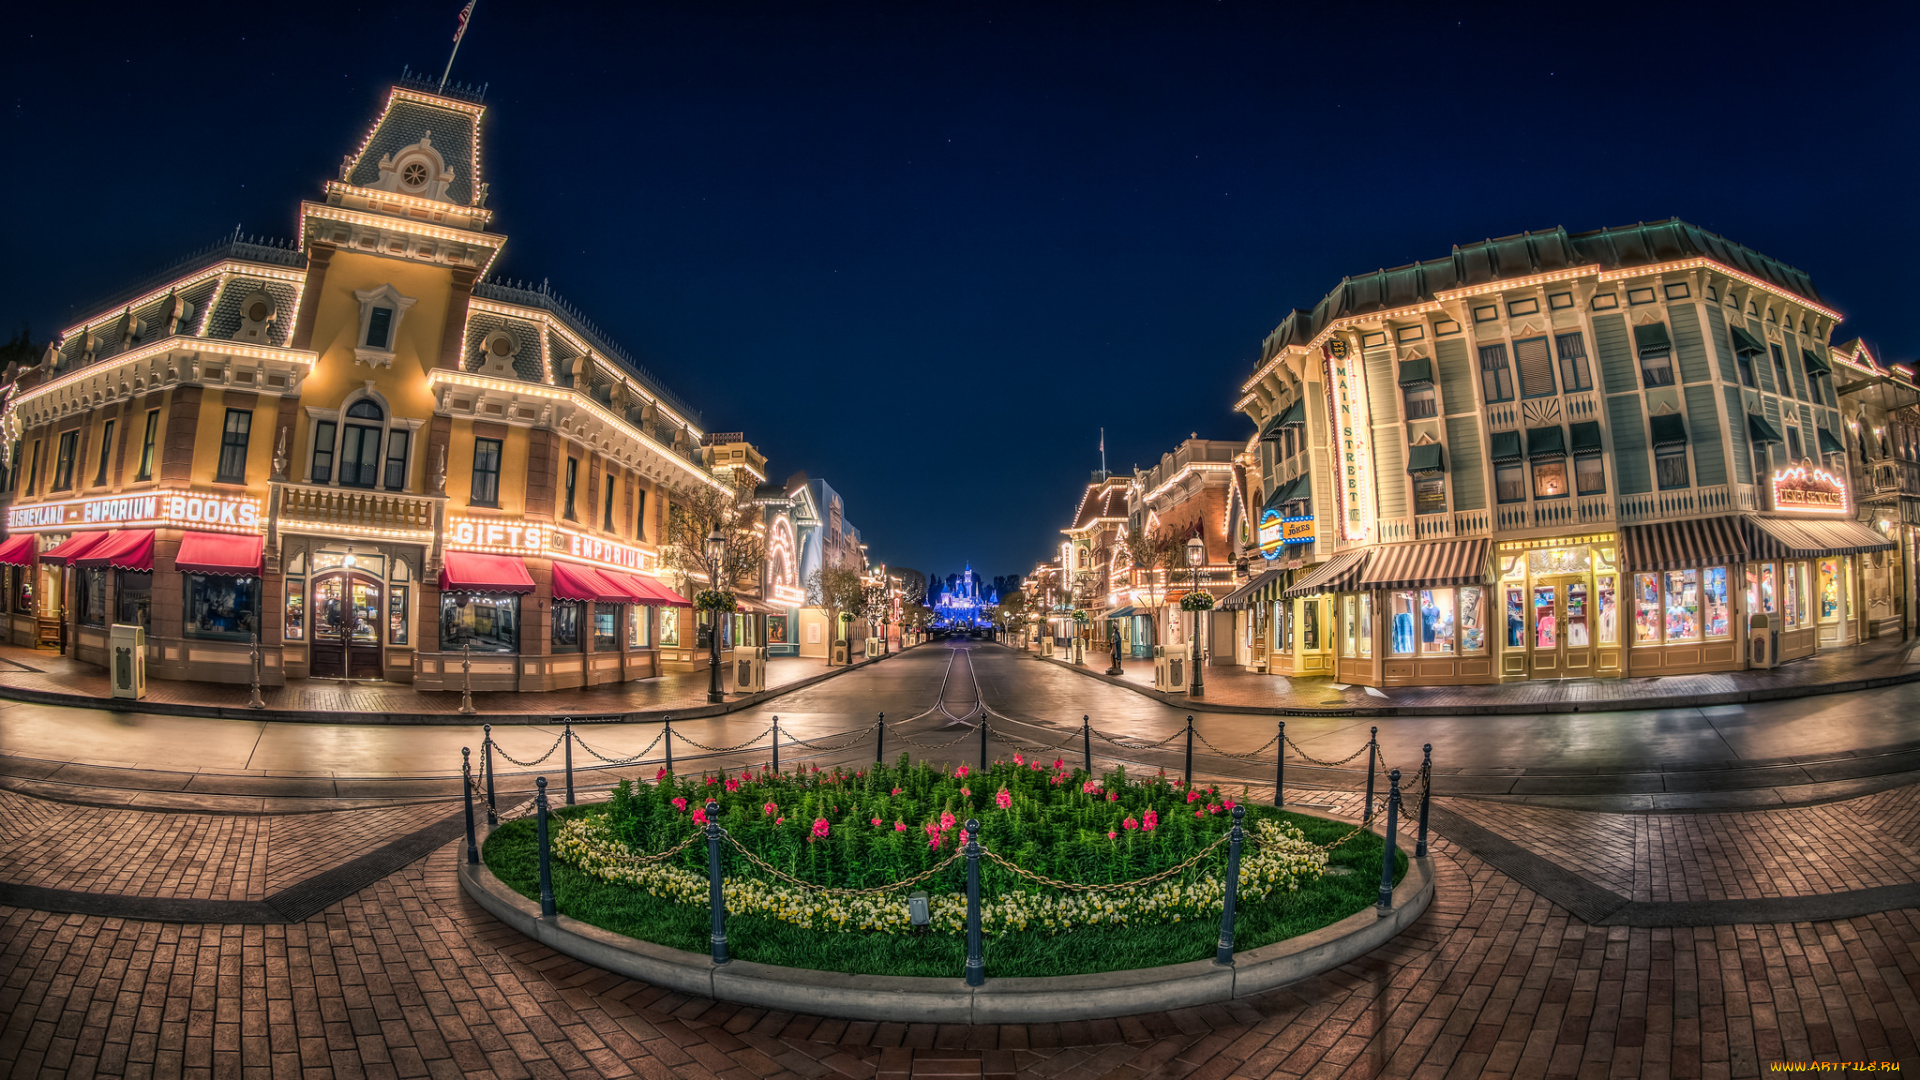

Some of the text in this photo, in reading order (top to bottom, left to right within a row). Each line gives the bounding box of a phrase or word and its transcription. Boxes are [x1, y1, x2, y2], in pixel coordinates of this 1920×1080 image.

[1337, 367, 1350, 414] MAIN
[1343, 426, 1358, 502] STREET
[9, 505, 65, 528] DISNEYLAND
[83, 497, 156, 523] EMPORIUM
[170, 497, 257, 526] BOOKS
[456, 522, 542, 549] GIFTS
[1287, 523, 1311, 536] JOKES
[572, 536, 645, 570] EMPORIUM
